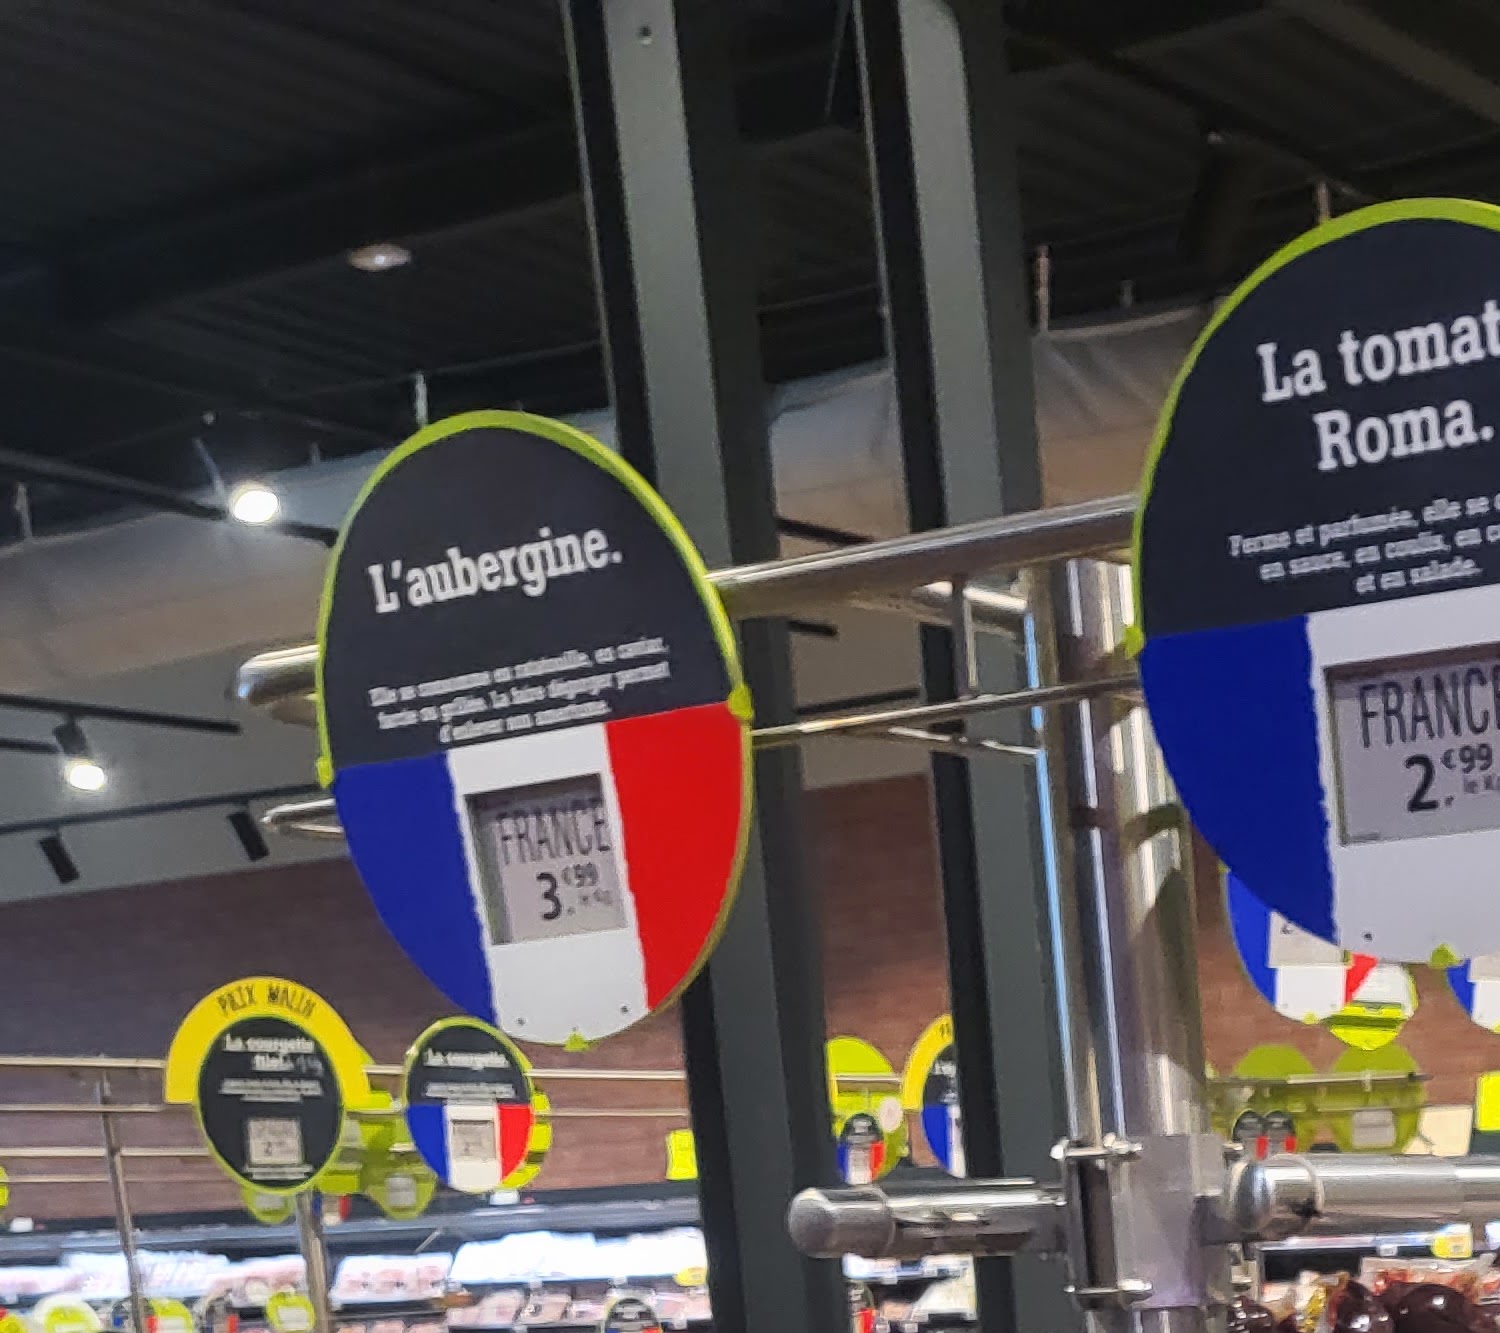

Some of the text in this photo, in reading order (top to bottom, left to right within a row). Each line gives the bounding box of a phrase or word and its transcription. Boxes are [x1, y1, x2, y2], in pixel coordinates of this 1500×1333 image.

[1256, 339, 1326, 403] La
[1312, 398, 1494, 472] Roma.
[369, 527, 623, 613] L'aubergine.
[496, 796, 611, 865] FRANCE
[217, 984, 256, 1019] PRIX
